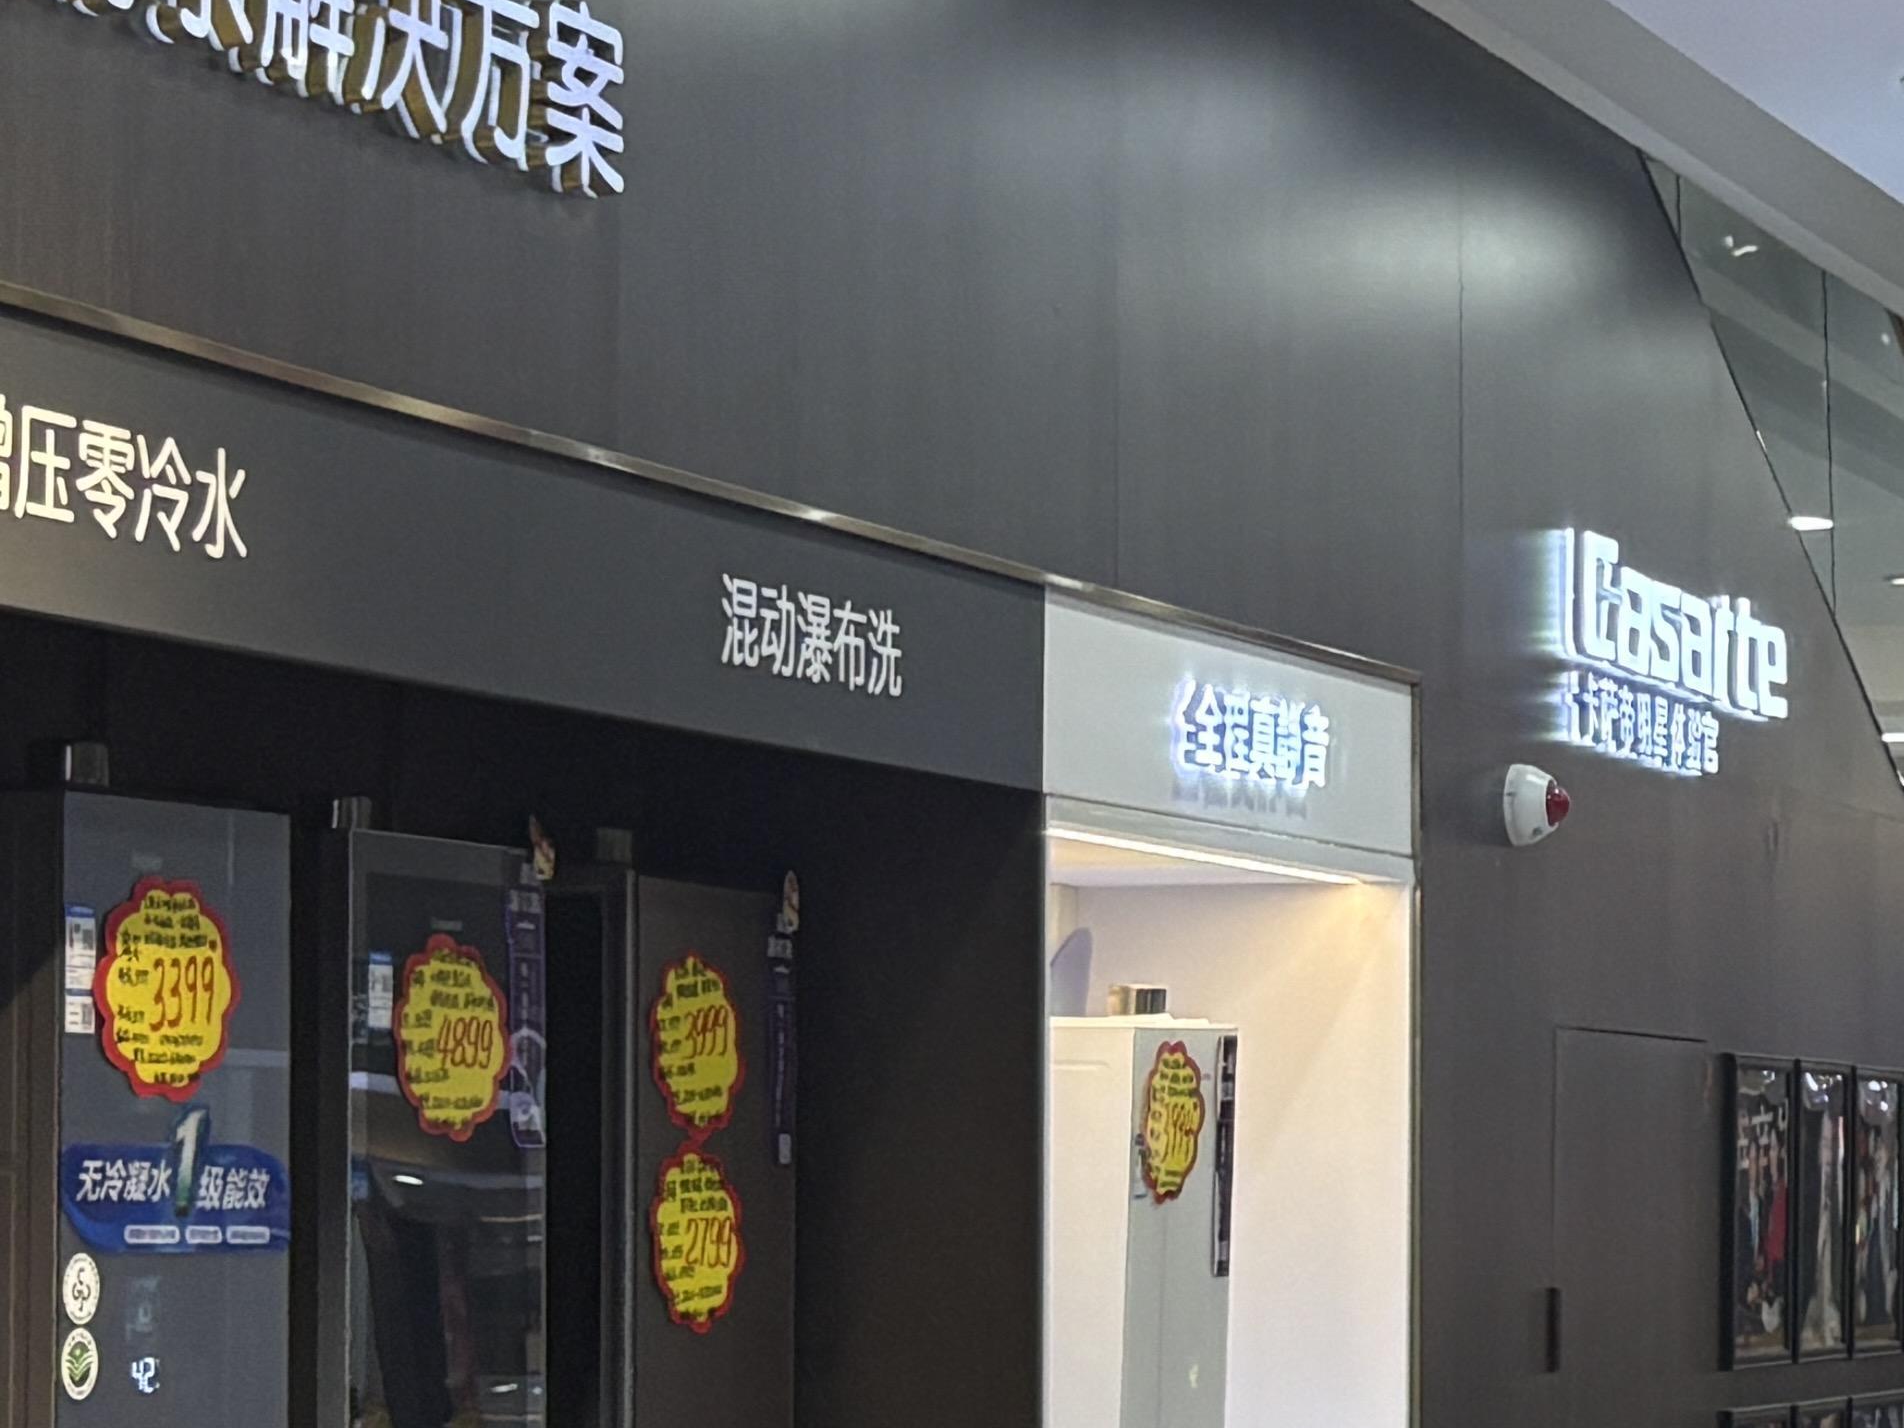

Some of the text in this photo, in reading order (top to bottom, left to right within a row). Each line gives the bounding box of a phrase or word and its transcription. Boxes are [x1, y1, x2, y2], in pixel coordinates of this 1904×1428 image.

[0, 398, 248, 558] 压零冷水
[720, 573, 904, 697] 混动瀑布洗
[1583, 529, 1788, 719] Casarte
[149, 955, 215, 1033] 3399
[683, 1004, 729, 1060] 3999
[436, 1016, 494, 1070] 4899
[683, 1216, 733, 1269] 2799
